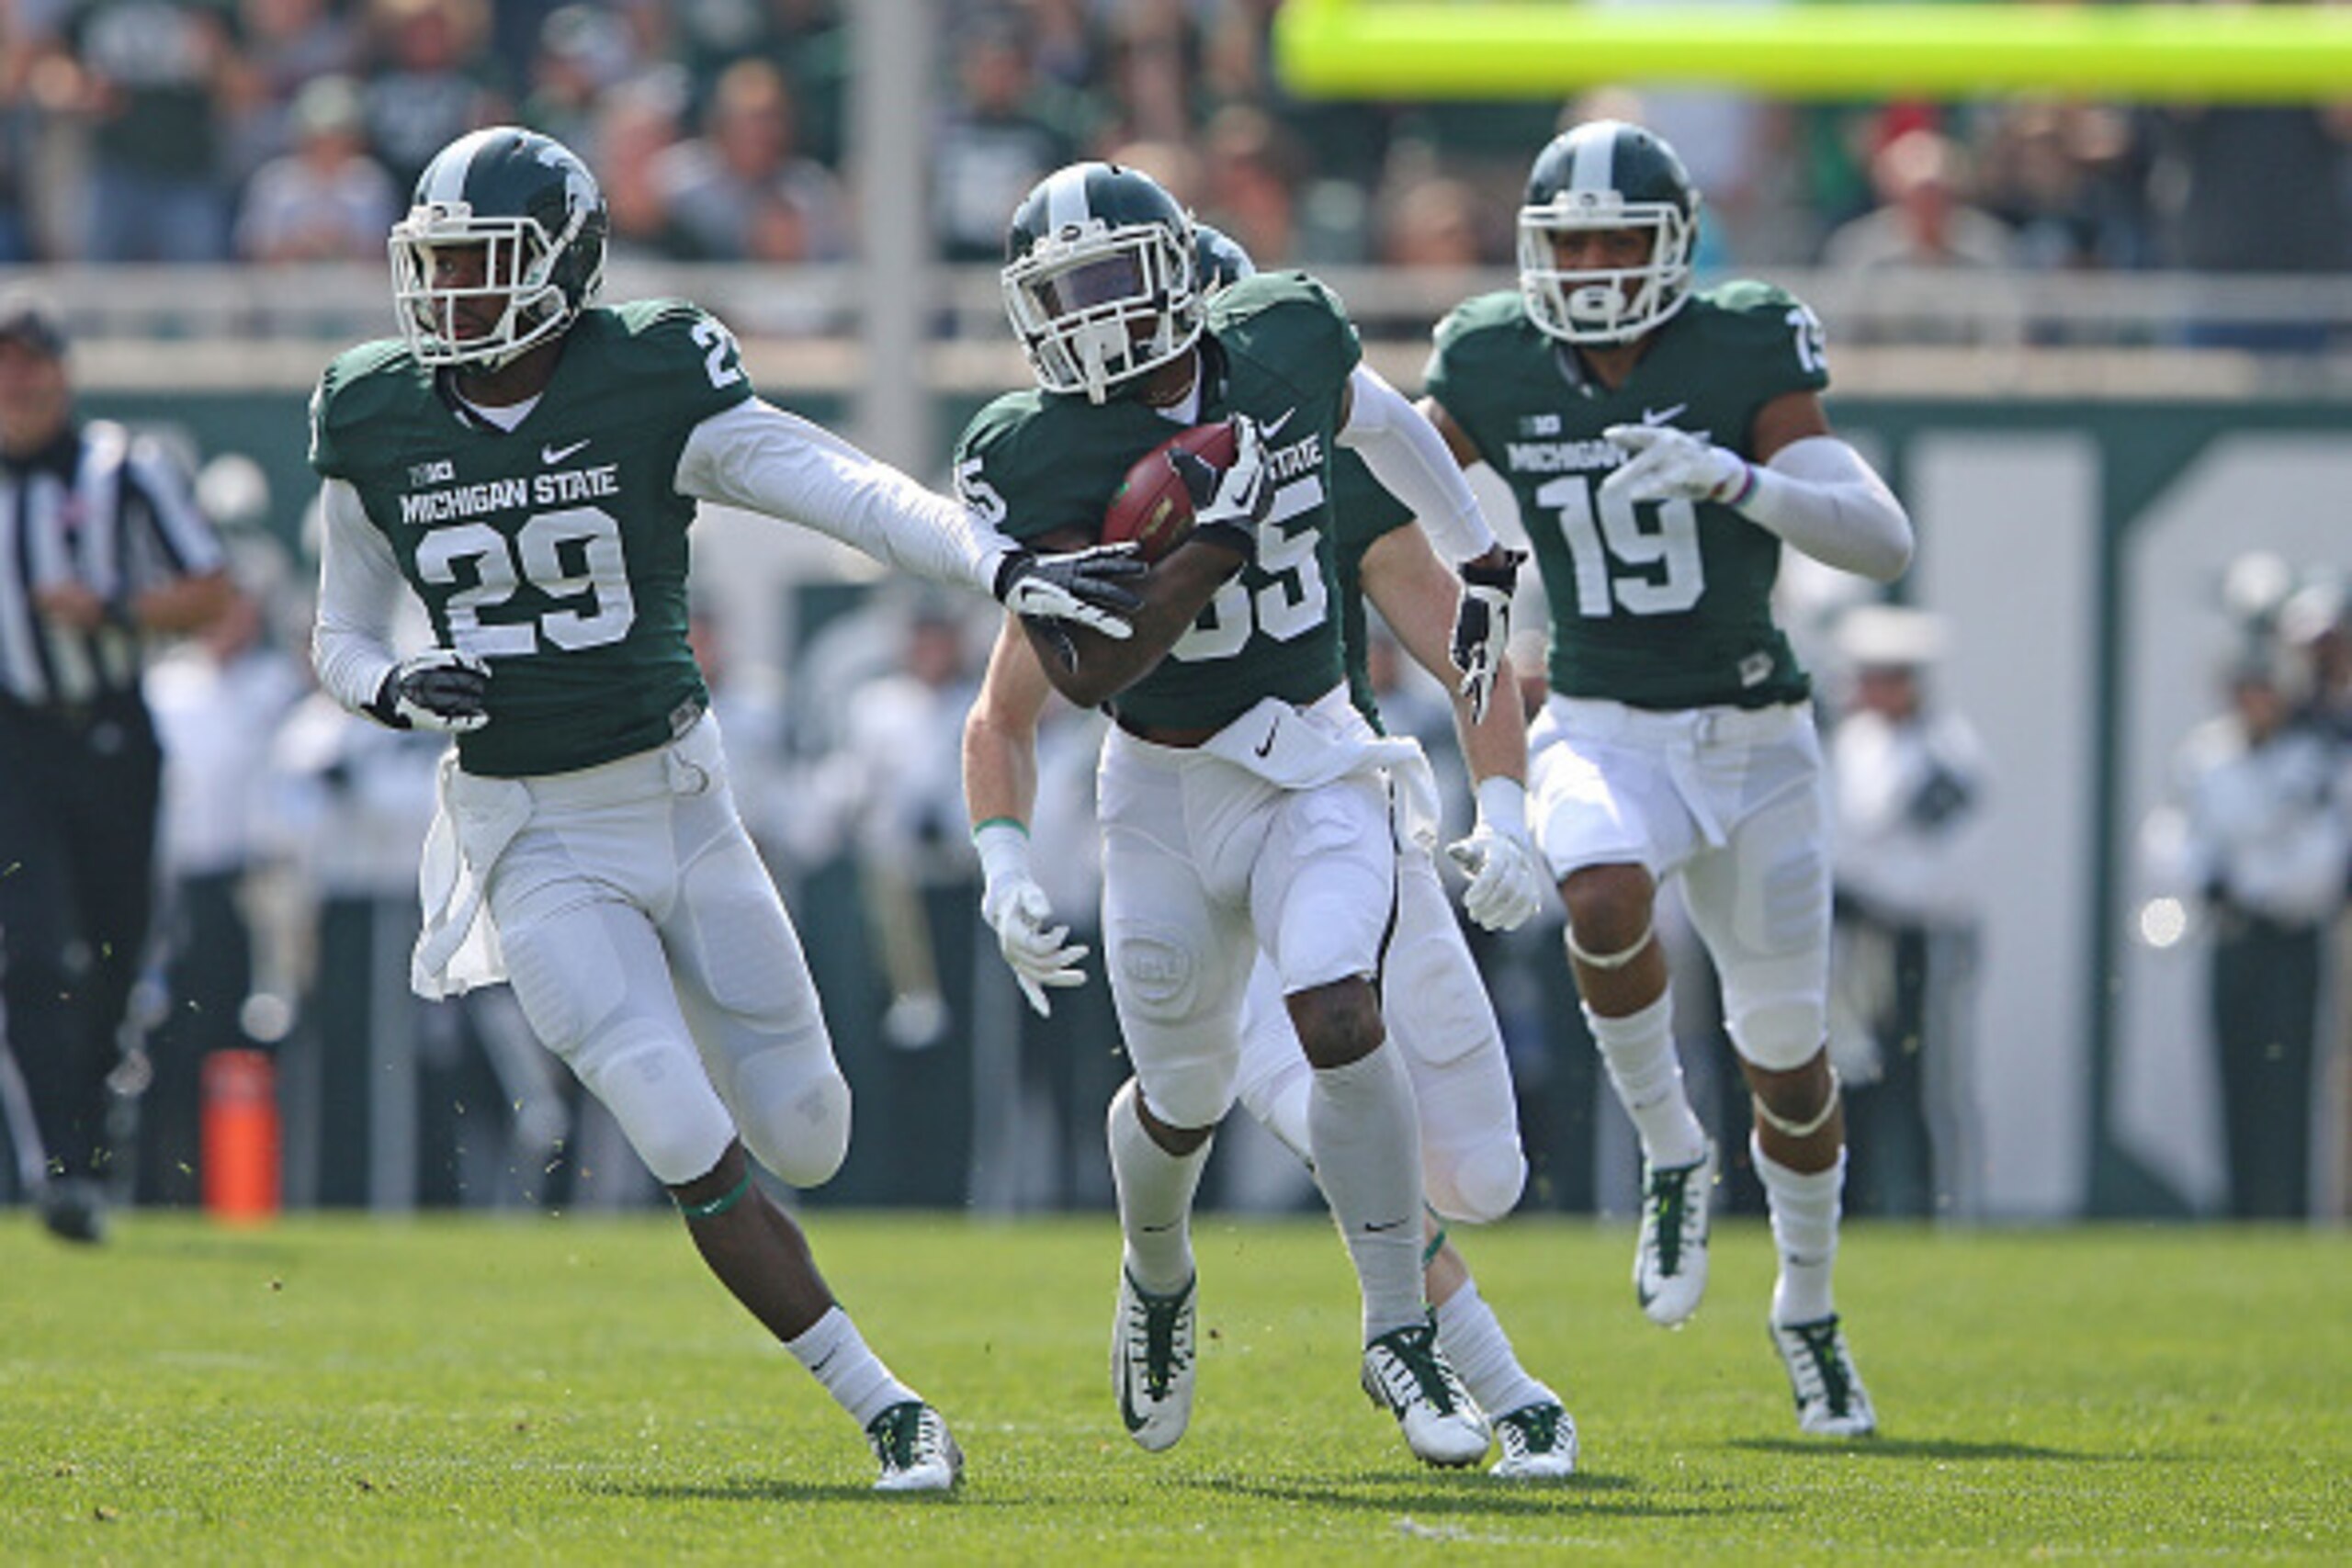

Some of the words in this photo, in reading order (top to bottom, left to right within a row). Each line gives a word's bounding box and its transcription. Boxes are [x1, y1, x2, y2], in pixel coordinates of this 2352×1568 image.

[690, 321, 746, 389] 2
[1268, 431, 1323, 480] TATE
[399, 478, 528, 525] MICHIGAN
[534, 463, 621, 504] STATE
[956, 457, 1007, 524] 5
[414, 505, 637, 655] 29
[1535, 475, 1706, 618] 19
